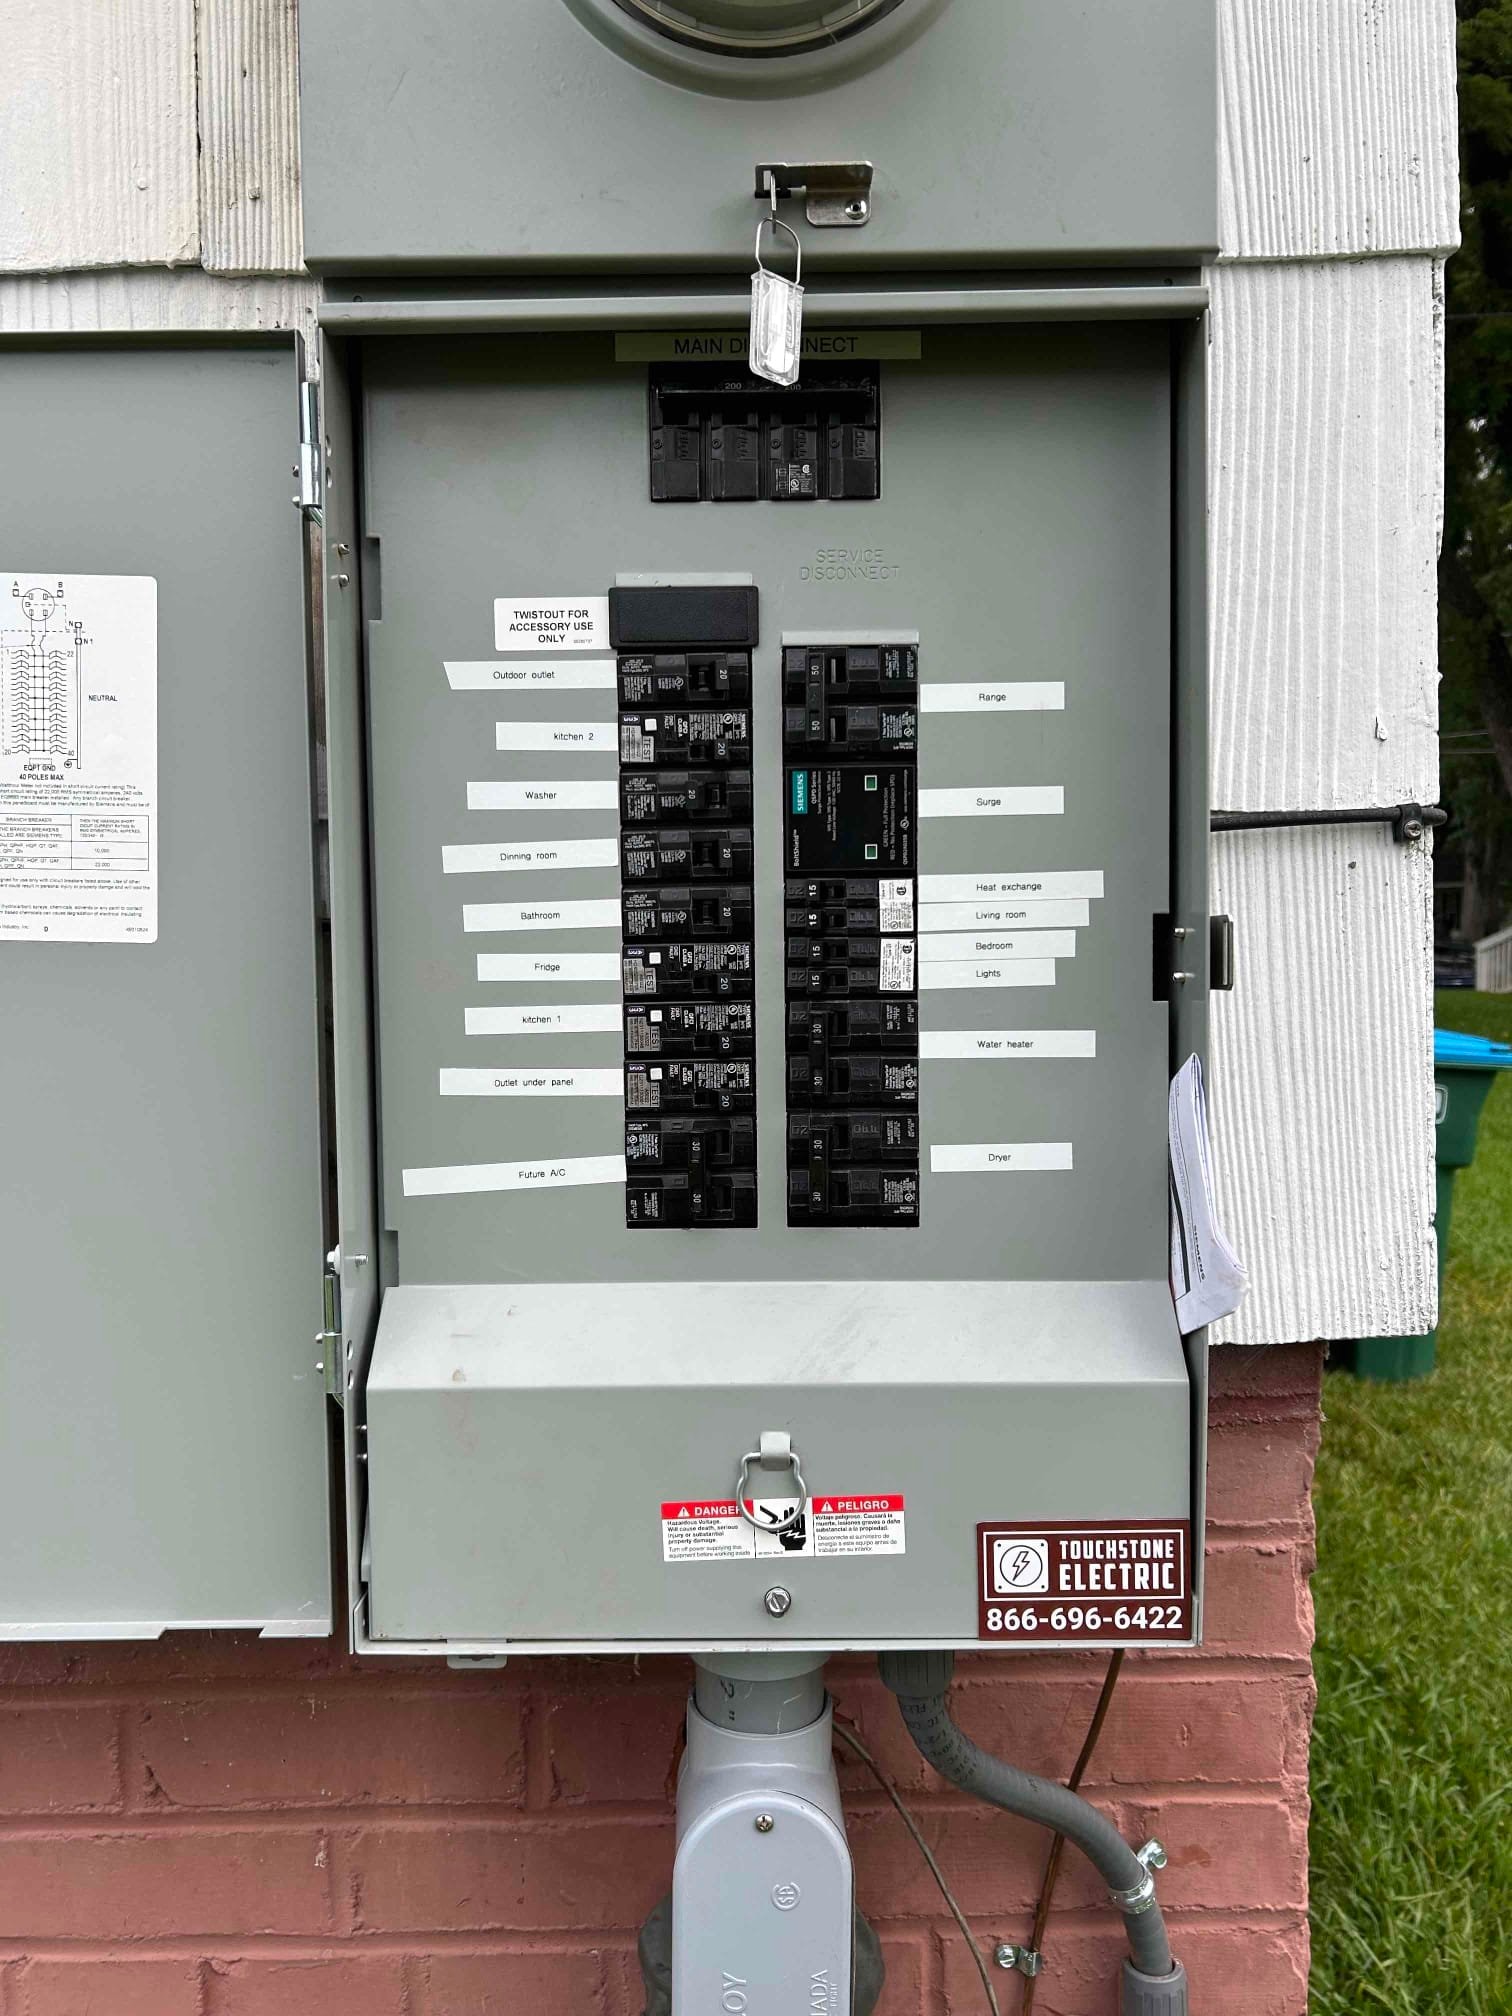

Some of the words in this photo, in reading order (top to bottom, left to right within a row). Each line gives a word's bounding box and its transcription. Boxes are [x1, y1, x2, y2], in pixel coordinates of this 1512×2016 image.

[674, 337, 722, 353] MAIN
[730, 337, 860, 352] DINECT
[724, 382, 742, 390] 200
[815, 549, 884, 563] SERVICE
[800, 566, 900, 581] DISCONNECT
[513, 610, 566, 619] TWISTOUT
[568, 610, 589, 618] FOR
[509, 622, 571, 631] ACCESSORY
[573, 622, 593, 630] USE
[538, 634, 565, 643] ONLY
[493, 670, 527, 680] Outdoor
[531, 670, 555, 679] outlet
[719, 669, 728, 680] 20
[811, 665, 819, 675] 50
[88, 694, 118, 702] NEUTRAL
[979, 692, 1007, 702] Range
[812, 720, 820, 731] 50
[553, 732, 583, 741] kitchen
[588, 732, 594, 740] 2
[643, 738, 651, 761] TEST
[718, 743, 726, 756] 20
[23, 764, 40, 772] EQPT
[525, 791, 557, 800] Washer
[688, 789, 696, 800] 20
[977, 797, 1001, 806] Surge
[500, 852, 532, 862] Dinning
[723, 848, 731, 859] 20
[808, 884, 817, 896] 15
[976, 883, 997, 892] Heat
[1002, 883, 1042, 892] exchange
[521, 911, 561, 920] Bathroom
[723, 907, 731, 917] 20
[976, 912, 1001, 921] Living
[1006, 911, 1026, 919] room
[808, 914, 817, 926] 15
[812, 945, 820, 957] 15
[976, 942, 1013, 951] Bedroom
[535, 962, 560, 972] Fridge
[976, 969, 1001, 979] Lights
[720, 977, 728, 990] 20
[812, 974, 820, 986] 15
[522, 1015, 552, 1024] kitchen
[556, 1015, 561, 1023] 1
[812, 1023, 822, 1035] 30
[651, 1028, 659, 1049] TEST
[721, 1037, 730, 1049] 20
[977, 1040, 1002, 1049] Water
[1007, 1040, 1034, 1049] heater
[494, 1079, 518, 1088] Outlet
[522, 1079, 547, 1087] under
[551, 1078, 574, 1088] panel
[814, 1076, 823, 1087] 30
[651, 1085, 659, 1106] TEST
[721, 1095, 730, 1107] 20
[692, 1141, 700, 1151] 30
[813, 1139, 823, 1150] 30
[989, 1153, 1012, 1163] Dryer
[519, 1170, 546, 1179] Future
[550, 1168, 566, 1178] A/C
[693, 1193, 702, 1203] 30
[812, 1191, 821, 1202] 30
[1194, 1224, 1206, 1281] SIEMENS
[837, 1500, 889, 1511] PELIGRO
[1059, 1539, 1175, 1560] TOUCHSTONE
[1059, 1562, 1175, 1591] ELECTRIC
[986, 1606, 1184, 1631] 866-696-6422
[721, 1972, 748, 2016] OY
